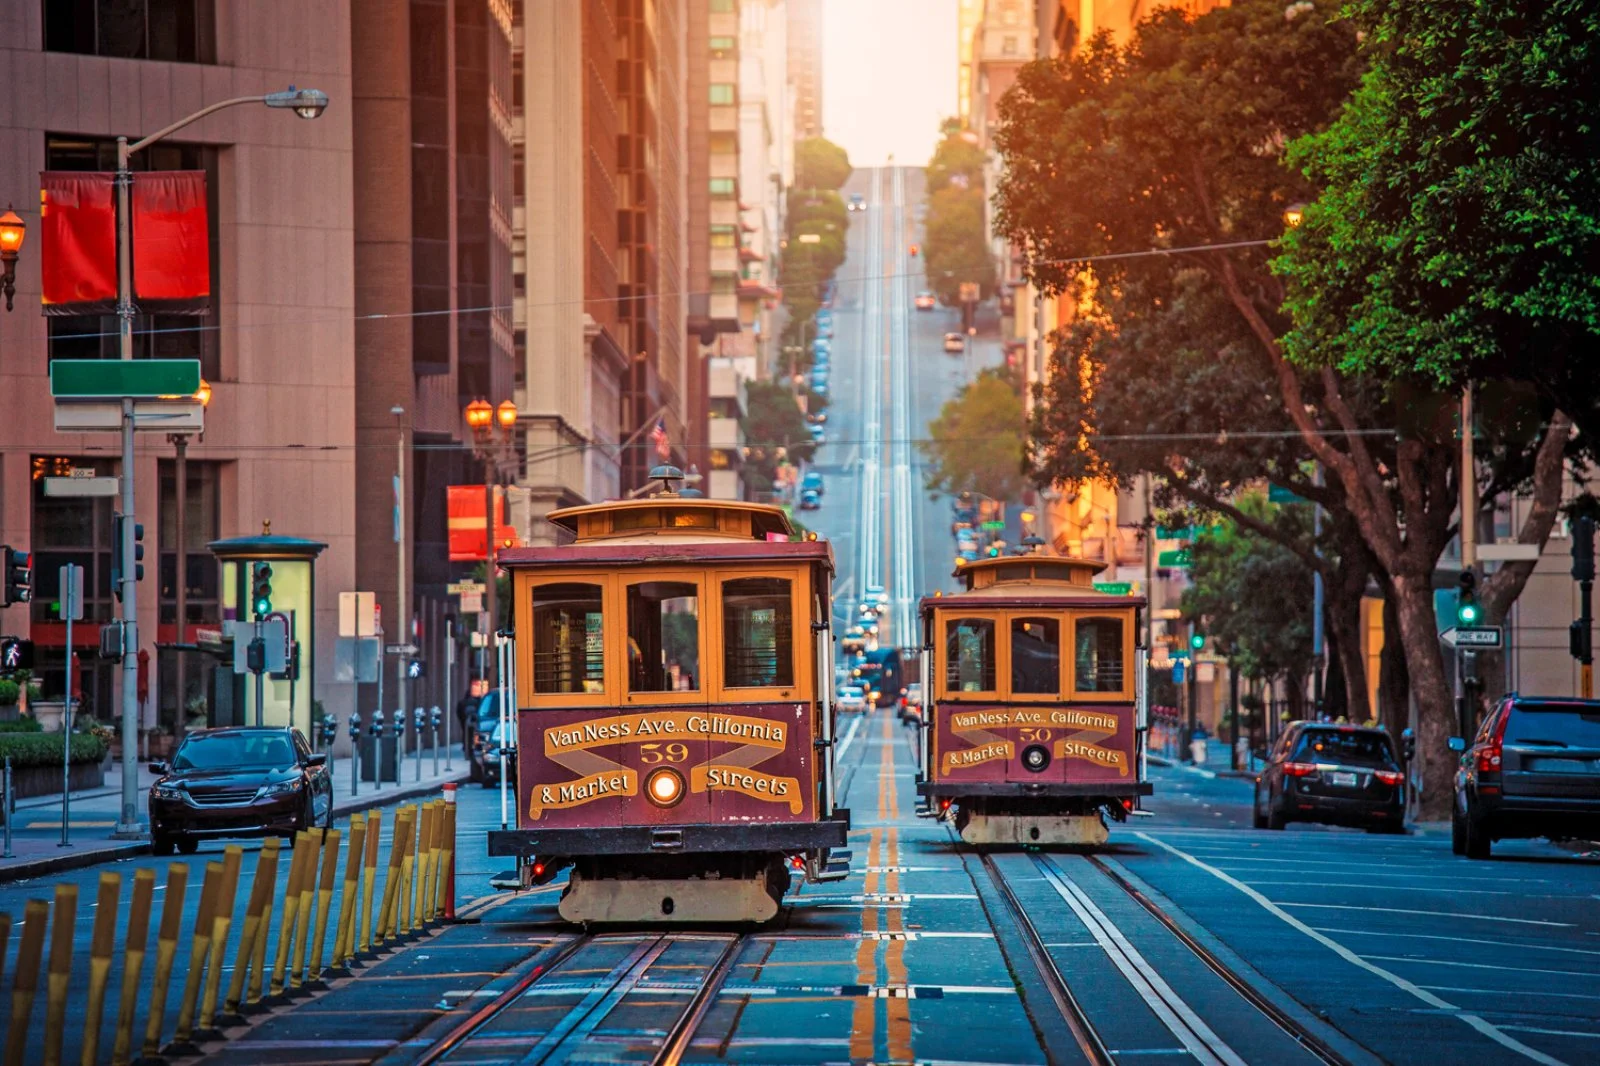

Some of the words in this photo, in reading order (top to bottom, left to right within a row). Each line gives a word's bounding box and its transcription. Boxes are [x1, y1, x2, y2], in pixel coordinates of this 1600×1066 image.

[584, 722, 631, 742] Ness
[687, 716, 783, 741] California
[1051, 711, 1116, 728] California
[640, 743, 689, 764] 59
[950, 752, 960, 764] &
[962, 744, 1010, 763] Market
[1064, 743, 1119, 763] Streets
[541, 786, 556, 804] &
[559, 775, 629, 803] Market
[707, 768, 789, 796] Streets
